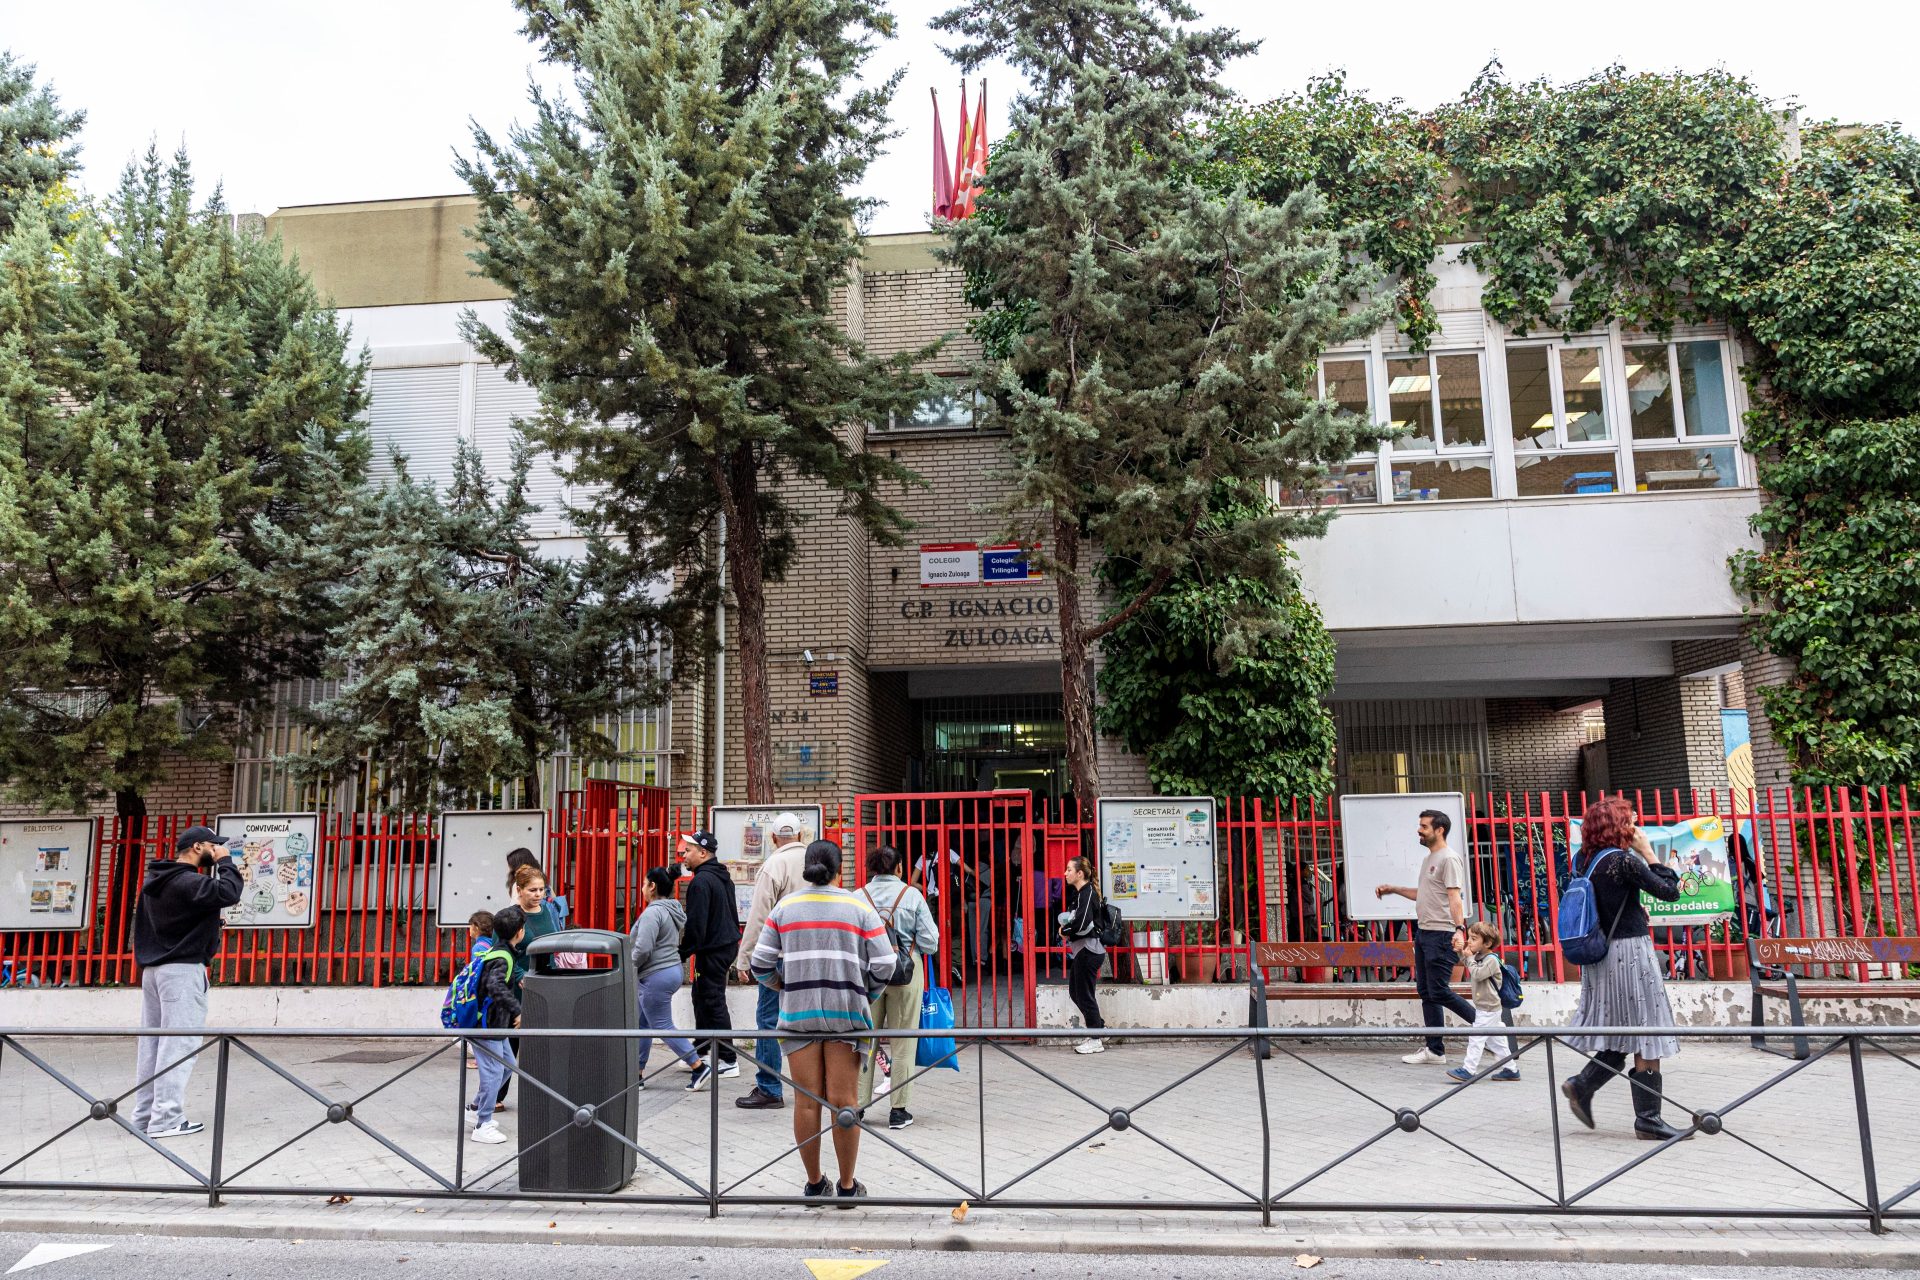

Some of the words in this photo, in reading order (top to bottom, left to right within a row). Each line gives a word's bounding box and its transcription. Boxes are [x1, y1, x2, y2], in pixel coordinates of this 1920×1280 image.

[928, 571, 948, 579] Ignacio
[901, 601, 933, 619] C.P.
[948, 597, 1054, 618] IGNACIO
[944, 626, 1055, 647] ZULOAGA
[1133, 806, 1181, 815] SECRETARÍA
[246, 824, 290, 832] CONVIVENCIA
[1654, 903, 1671, 911] los
[1673, 901, 1719, 912] pedales
